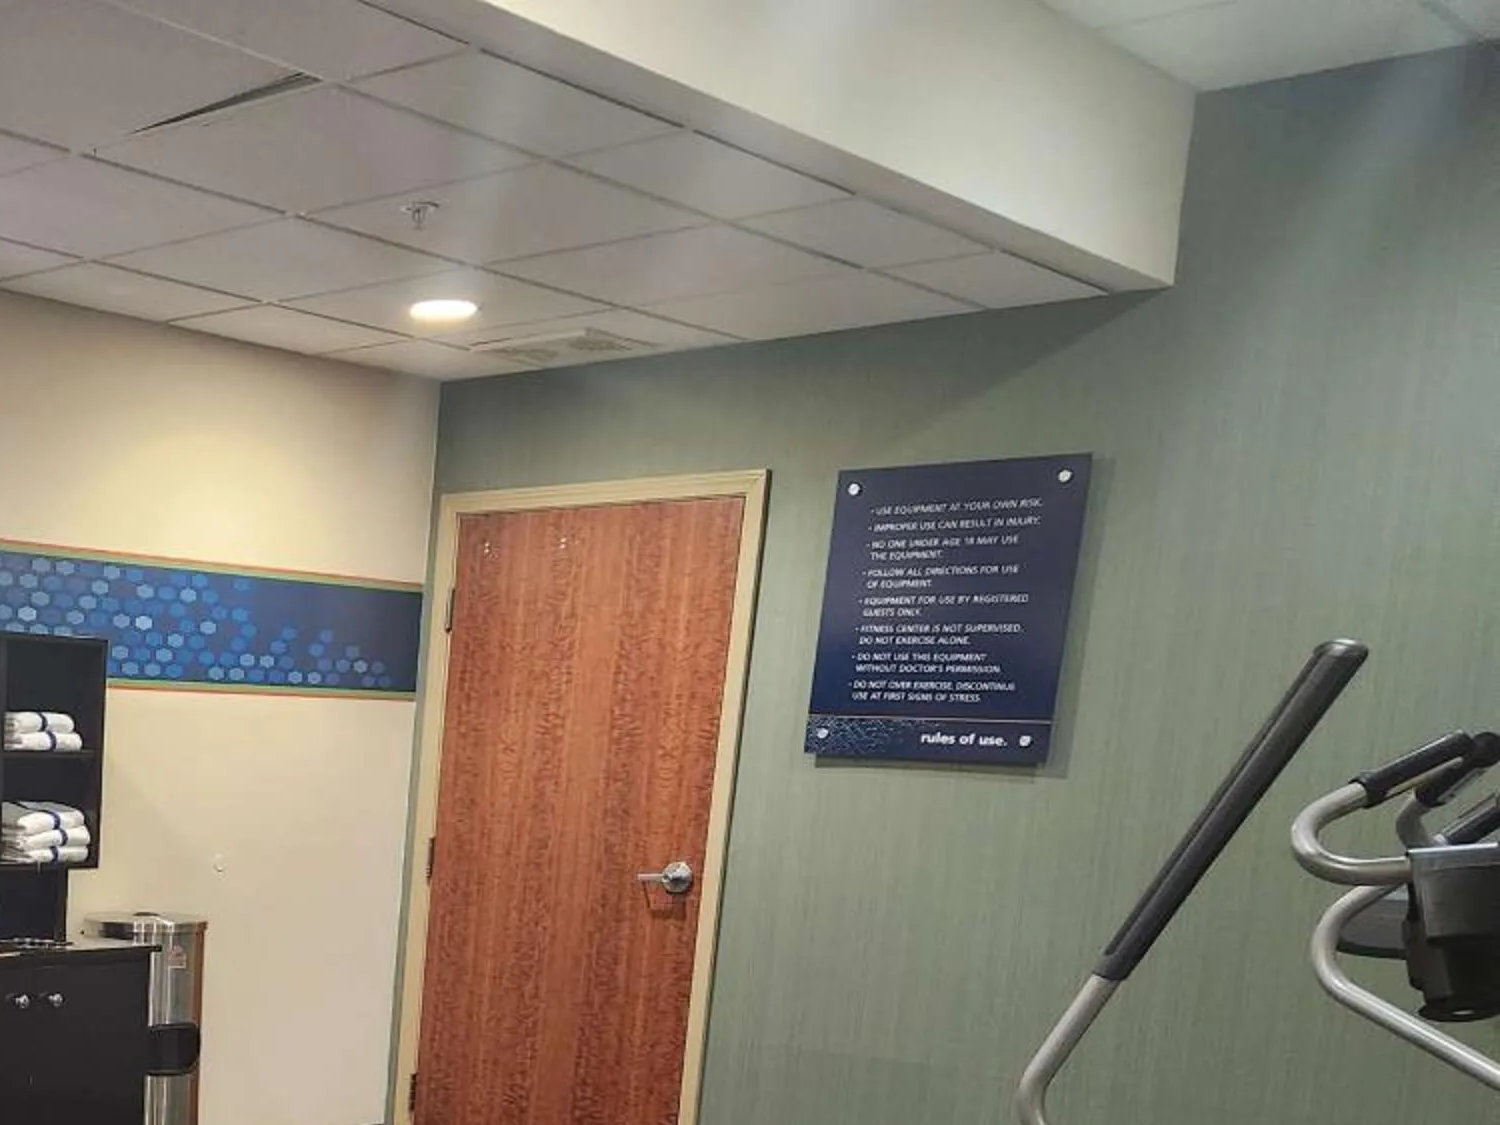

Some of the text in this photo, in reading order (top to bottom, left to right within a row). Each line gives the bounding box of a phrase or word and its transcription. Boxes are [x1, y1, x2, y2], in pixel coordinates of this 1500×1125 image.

[894, 503, 947, 514] EQUIPMENT
[964, 501, 990, 511] YOUR
[993, 499, 1017, 509] OWN
[874, 522, 917, 532] IMPROPER
[920, 521, 936, 531] USE
[938, 520, 957, 529] CAN
[960, 518, 991, 529] RESULT
[994, 518, 1003, 527] IN
[872, 541, 886, 549] NO
[888, 540, 906, 548] ONE
[910, 538, 939, 547] UNDER
[942, 537, 960, 546] AGE
[976, 535, 998, 545] MAY
[1001, 535, 1019, 544] USE
[871, 552, 887, 560] THE
[867, 565, 1019, 577] FOLLOW ALL DIRECTIONS FOR USE
[866, 580, 878, 589] OF
[864, 594, 1029, 605] EQUIPMENT FOR USE BY REGISTERED
[863, 608, 895, 617] GUESTS
[860, 624, 894, 634] FITNESS
[896, 624, 930, 633] CENTER
[932, 624, 940, 633] IS
[942, 624, 962, 633] NOT
[859, 636, 873, 645] DO
[875, 636, 894, 645] NOT
[896, 636, 935, 645] EXERCISE
[857, 653, 987, 662] DO NOT USE THIS EQUIPMENT
[855, 664, 897, 673] WITHOUT
[899, 664, 943, 673] DOCTOR'S
[853, 680, 866, 688] DO
[869, 680, 887, 689] NOT
[888, 680, 911, 689] OVER
[955, 681, 1015, 691] DISCONTINUE
[852, 692, 868, 700] USE
[870, 692, 881, 700] AT
[883, 692, 905, 700] FIRST
[907, 693, 932, 701] SIGNS
[935, 693, 948, 701] OF
[921, 731, 1008, 746] rules of use.
